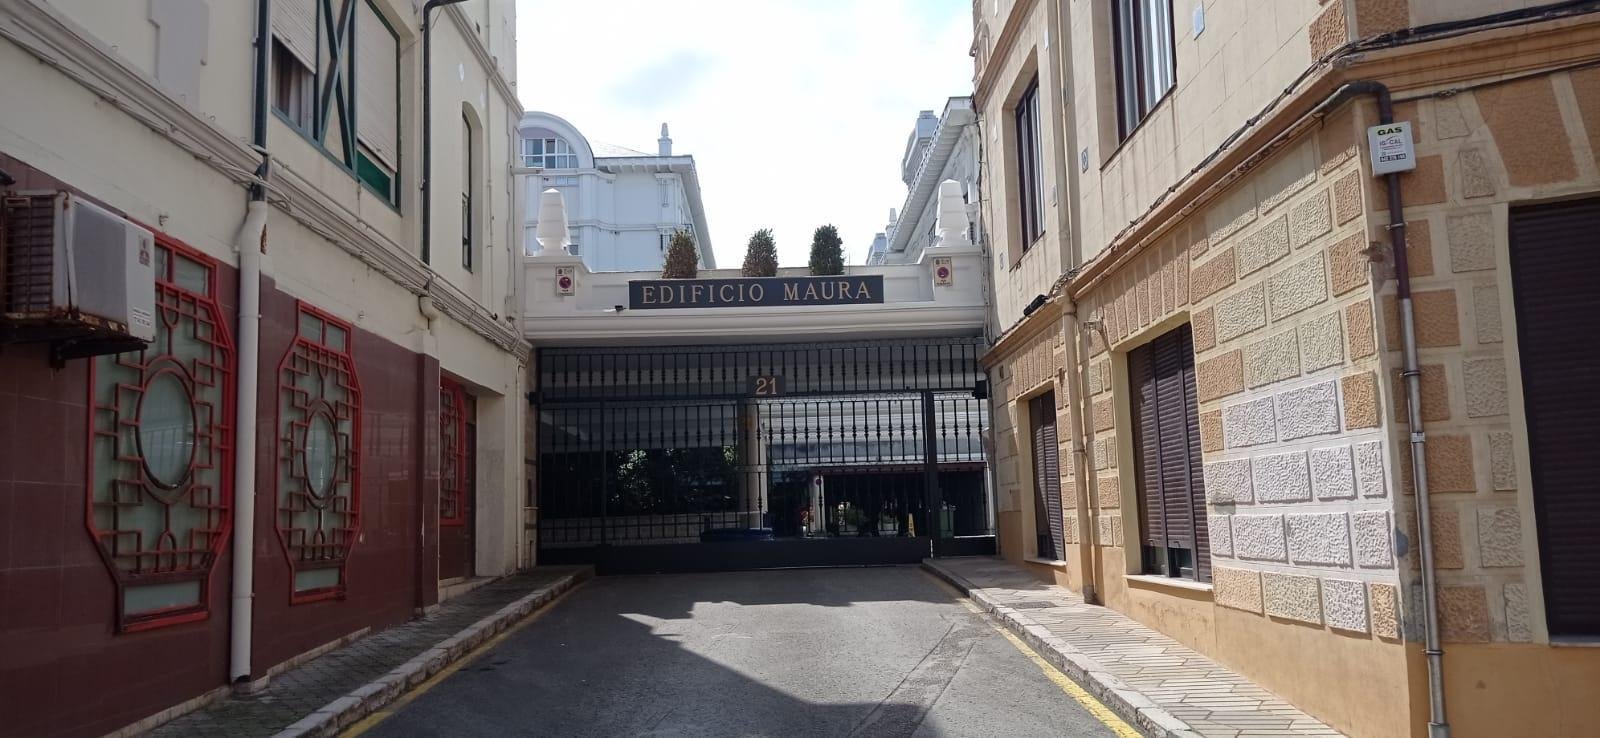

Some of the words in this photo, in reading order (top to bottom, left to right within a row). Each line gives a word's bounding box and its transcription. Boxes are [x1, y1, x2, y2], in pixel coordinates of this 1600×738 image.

[1377, 127, 1402, 135] GAS
[642, 283, 764, 304] EDIFICIO
[783, 281, 871, 301] MAURA
[755, 377, 777, 395] 21
